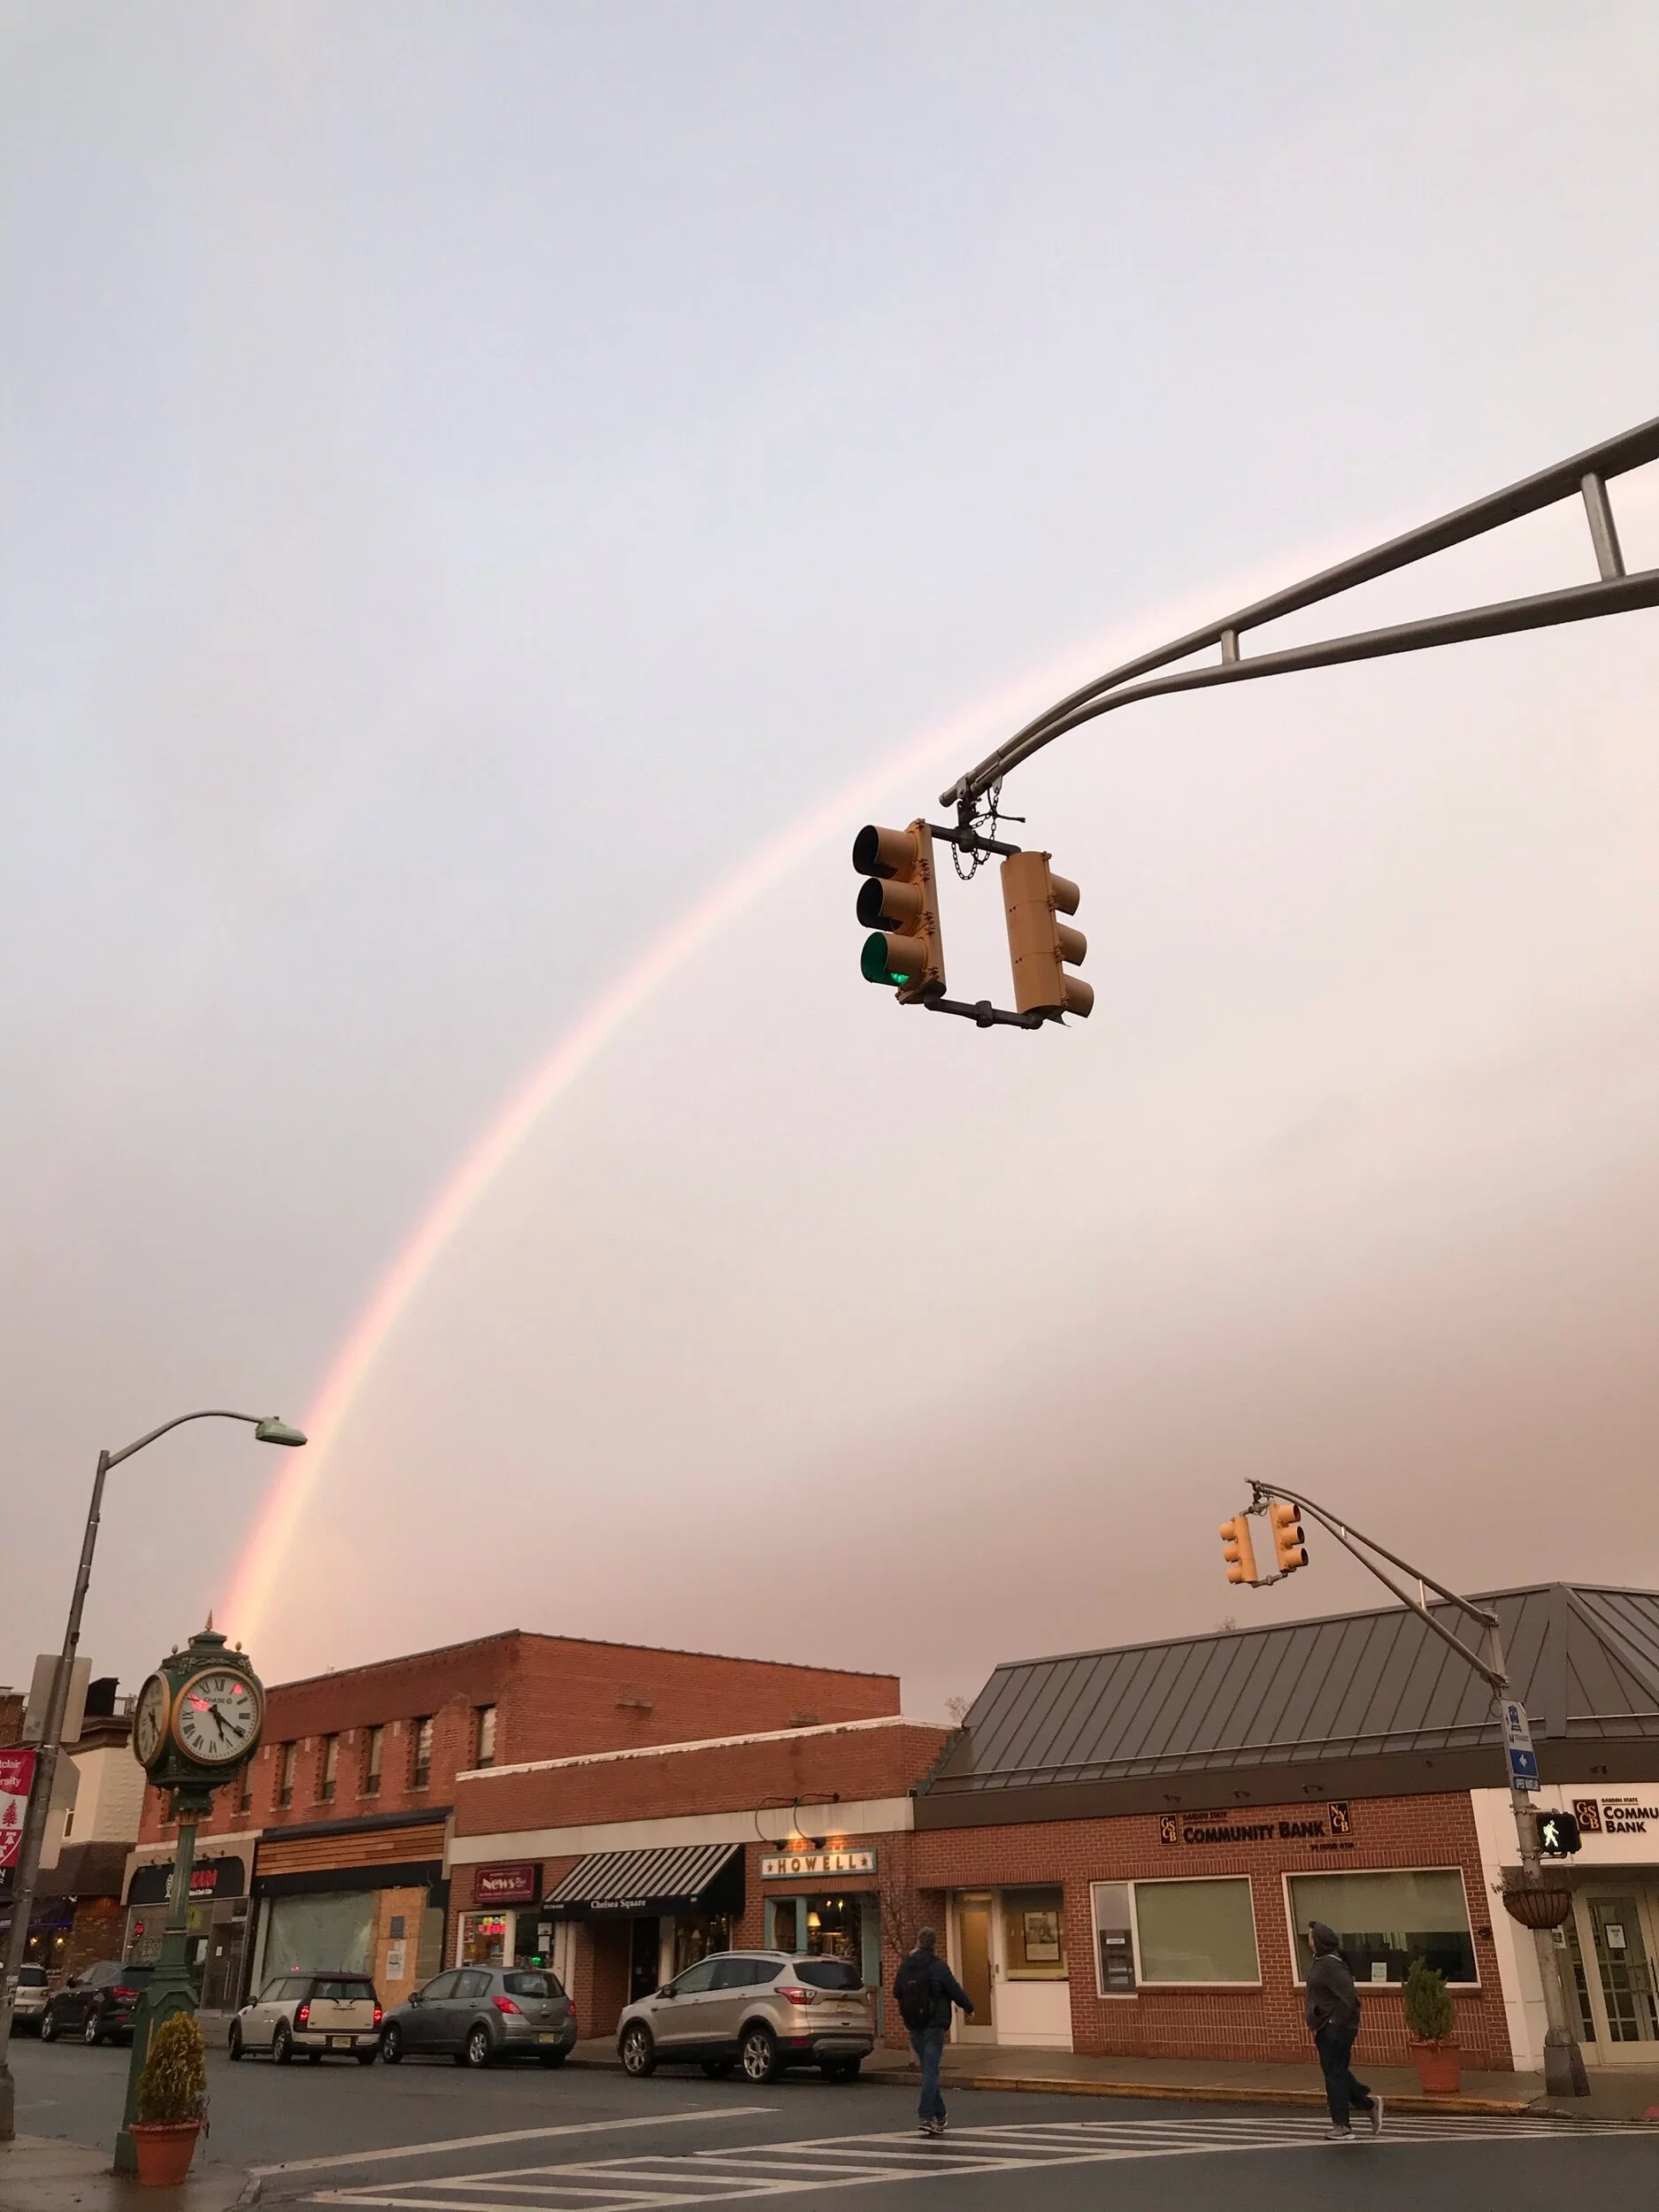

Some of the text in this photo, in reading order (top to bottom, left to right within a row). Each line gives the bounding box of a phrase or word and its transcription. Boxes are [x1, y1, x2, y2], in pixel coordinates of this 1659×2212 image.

[1184, 1819, 1325, 1843] COMMUNITY BANK
[1605, 1820, 1647, 1833] BANK
[778, 1855, 856, 1873] HOWELL
[590, 1899, 647, 1910] Chelsea Square
